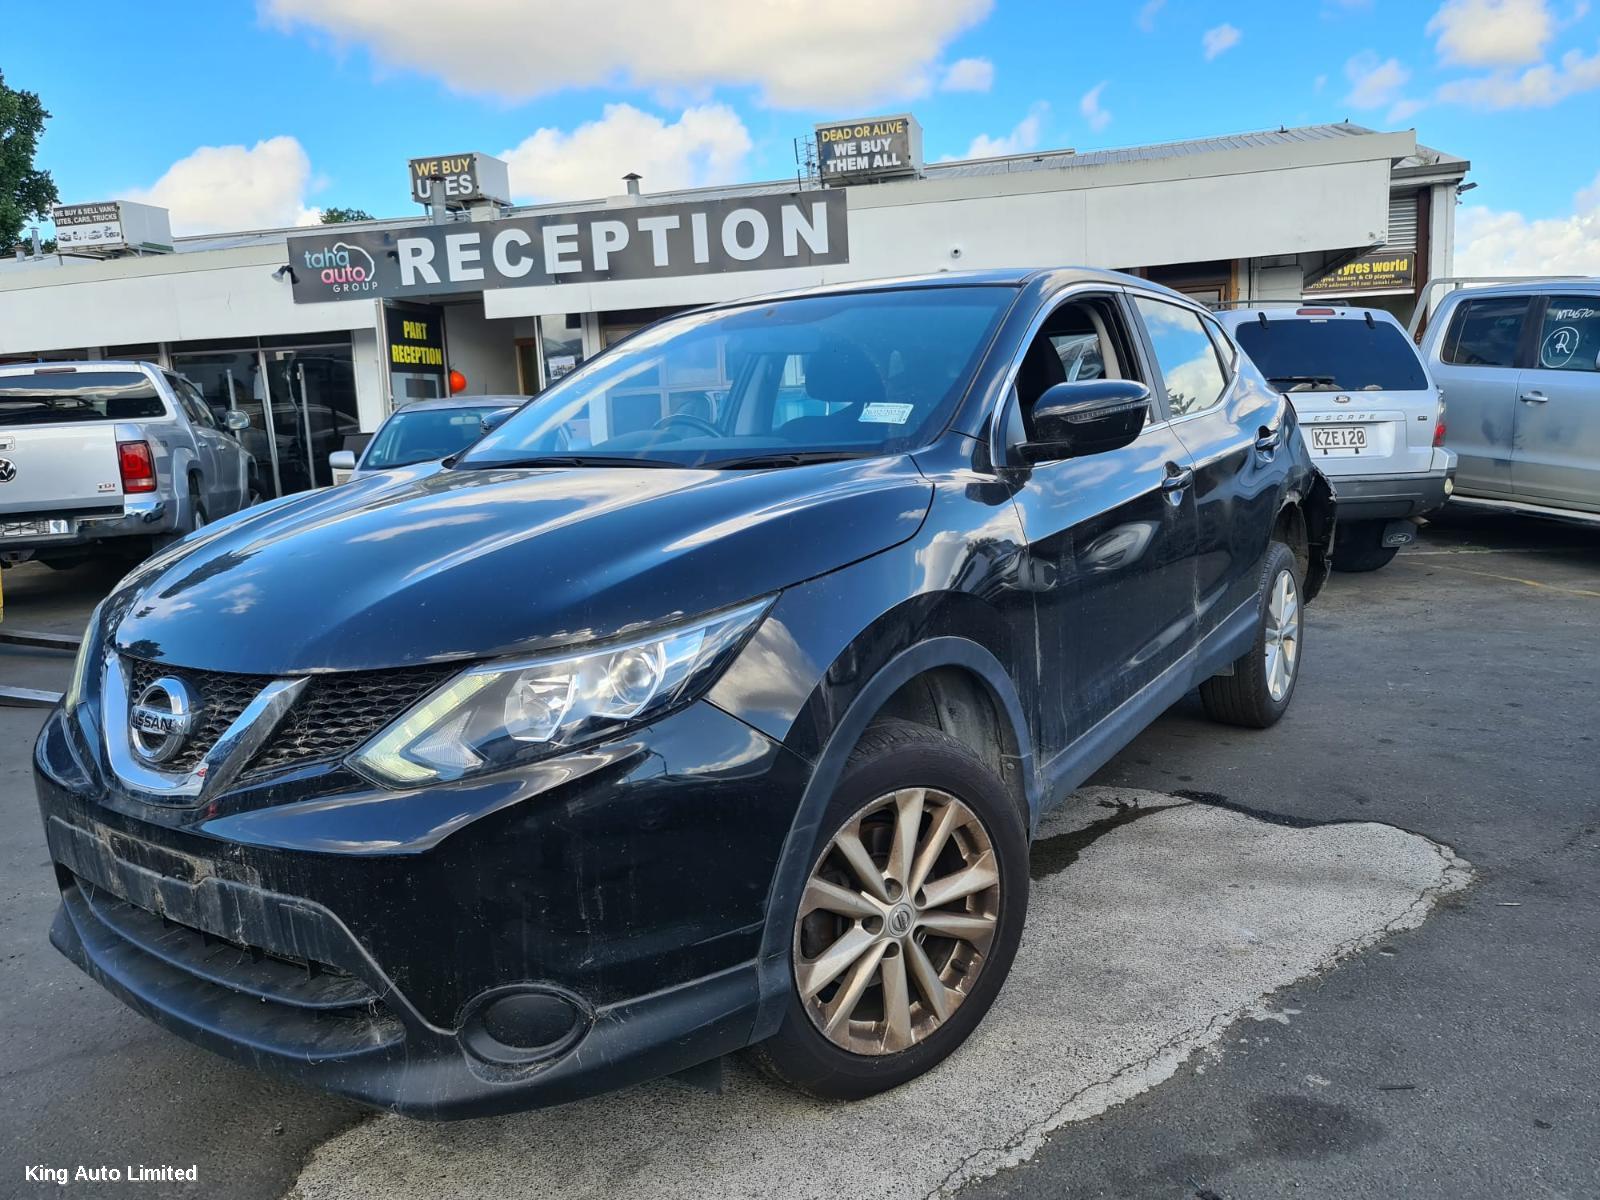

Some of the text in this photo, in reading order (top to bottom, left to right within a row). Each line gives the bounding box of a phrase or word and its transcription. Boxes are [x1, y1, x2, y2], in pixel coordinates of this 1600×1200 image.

[822, 121, 903, 142] DEAD OR ALIVE
[833, 138, 892, 157] WE BUY
[415, 158, 470, 176] WE BUY
[827, 153, 902, 173] THEM ALL
[416, 174, 473, 198] UES
[54, 210, 64, 218] WE
[64, 209, 77, 217] BUY
[83, 207, 99, 215] SELL
[56, 217, 74, 226] UTES,
[92, 213, 117, 221] TRUCKS
[397, 201, 829, 286] RECEPTION
[304, 247, 350, 268] taha
[1372, 258, 1408, 273] world
[321, 264, 366, 284] auto
[333, 281, 378, 293] GROUP
[403, 320, 427, 340] PART
[1553, 330, 1570, 353] R
[391, 344, 442, 365] RECEPTION
[1314, 430, 1365, 446] KZE120
[131, 708, 172, 730] NISSAN
